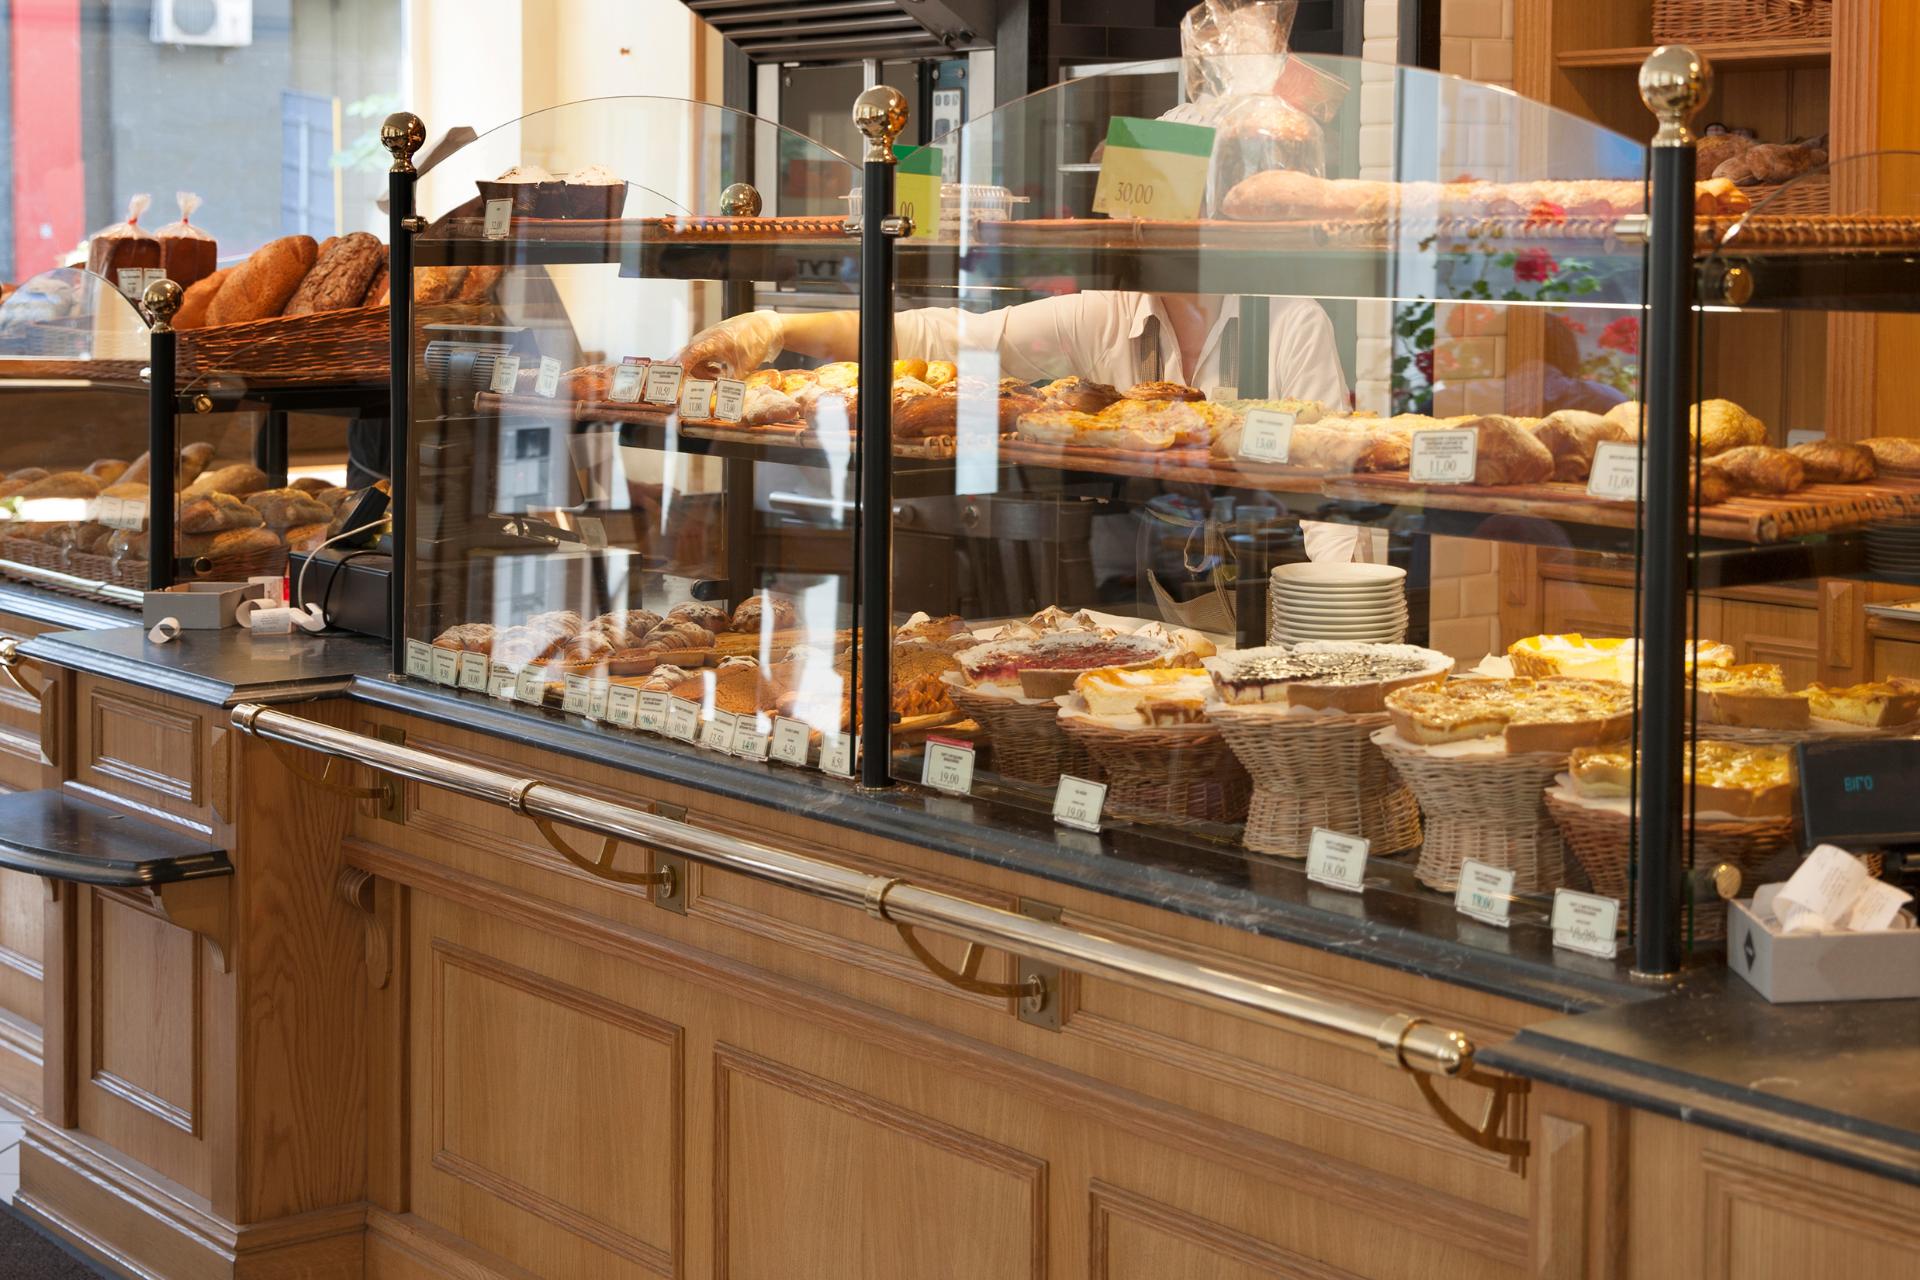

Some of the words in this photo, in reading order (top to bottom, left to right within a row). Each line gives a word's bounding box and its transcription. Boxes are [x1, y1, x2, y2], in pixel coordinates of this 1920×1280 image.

[1115, 182, 1153, 205] 30,00
[1429, 459, 1456, 473] 11,00
[1608, 474, 1634, 489] 11,00
[939, 770, 960, 785] 19,00
